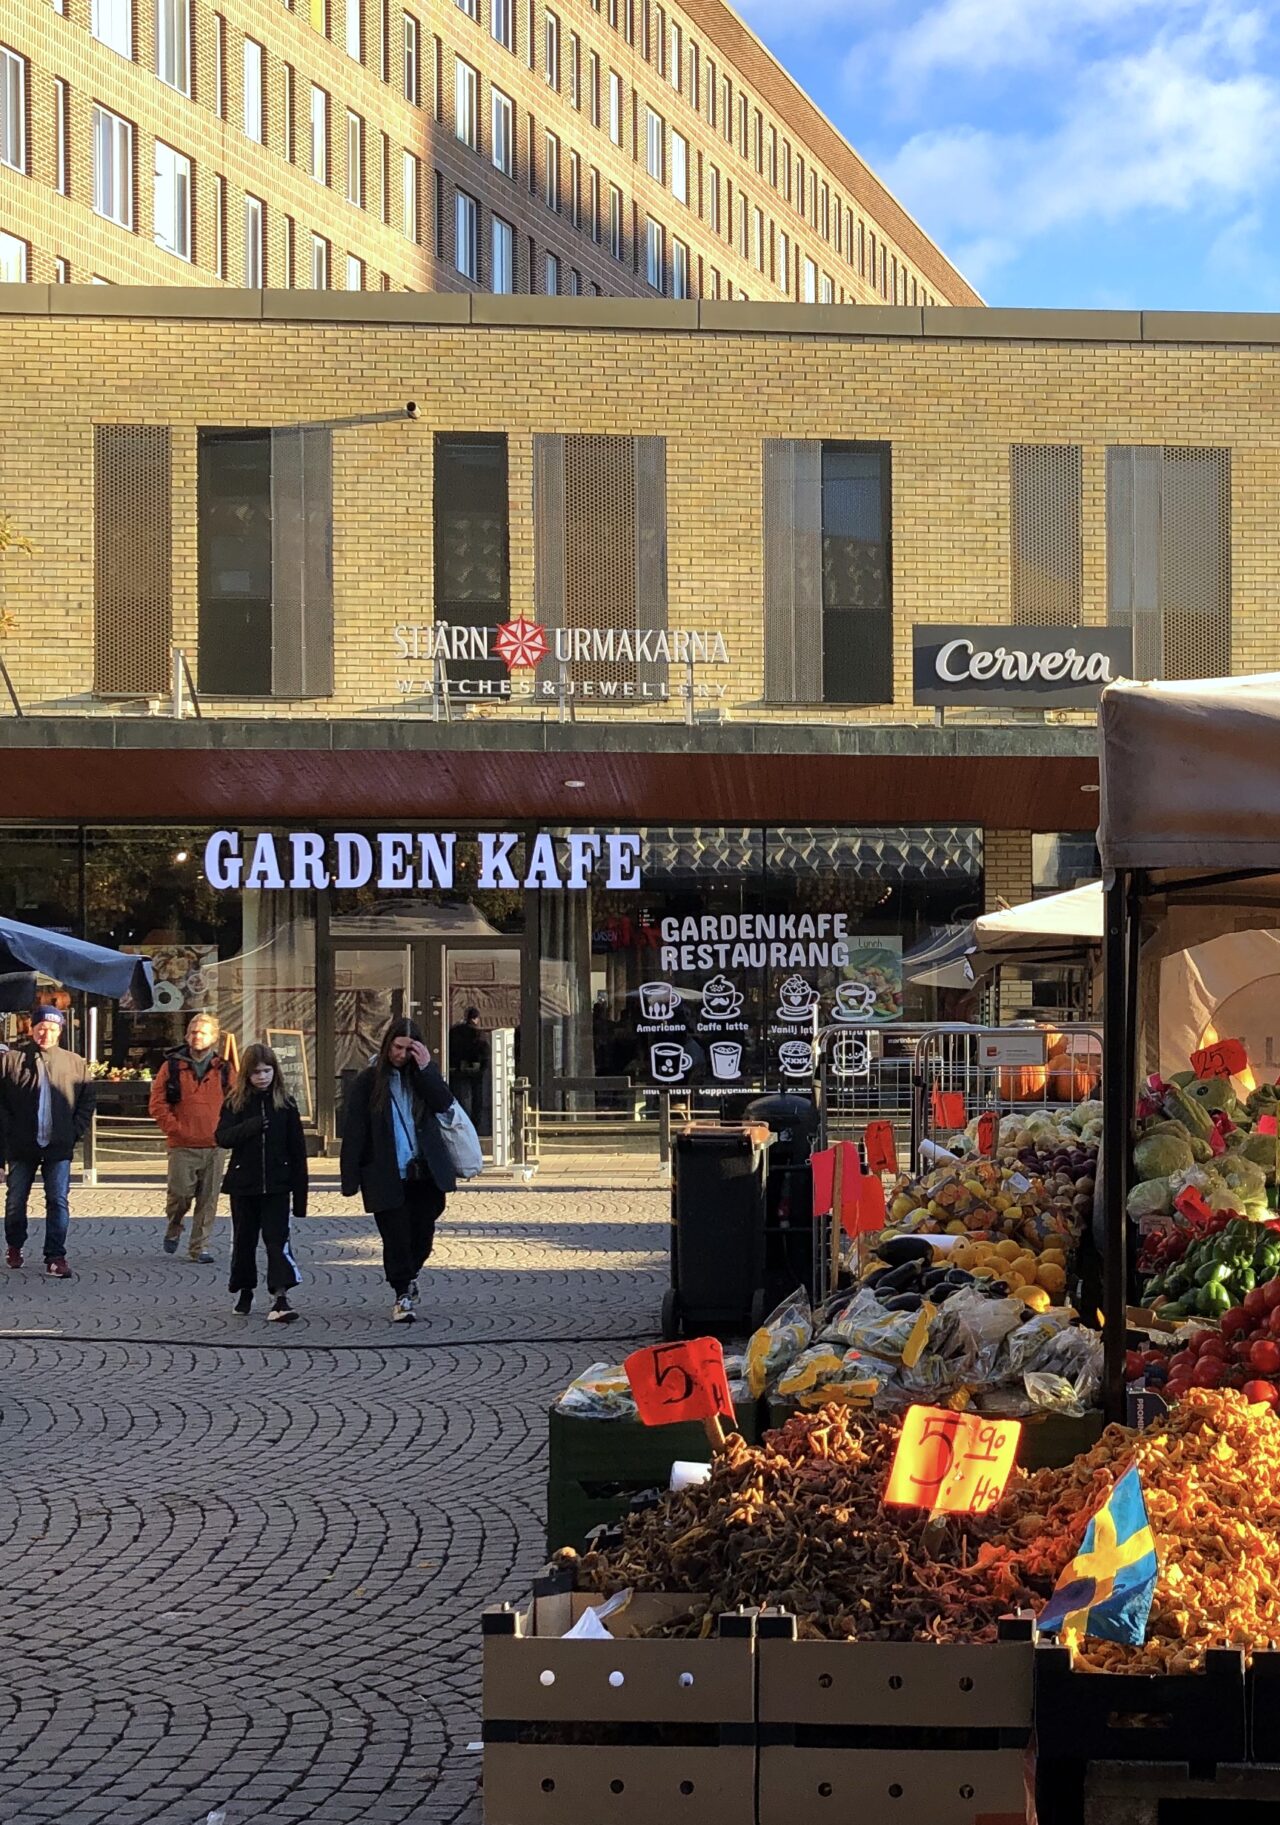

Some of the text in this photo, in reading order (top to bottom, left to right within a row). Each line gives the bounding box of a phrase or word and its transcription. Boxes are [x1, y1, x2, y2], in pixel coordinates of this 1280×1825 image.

[393, 620, 729, 663] STJÄRN URMAKARNA
[935, 639, 1114, 682] Cervera
[395, 679, 728, 698] WATCHES & JEWELLERY
[204, 830, 641, 890] GARDEN KAFE
[661, 913, 849, 942] GARDENKAFE
[661, 942, 849, 971] RESTAURANG
[636, 1023, 686, 1033] Americano
[697, 1021, 749, 1032] Caffe latte
[771, 1025, 798, 1035] Vanilj
